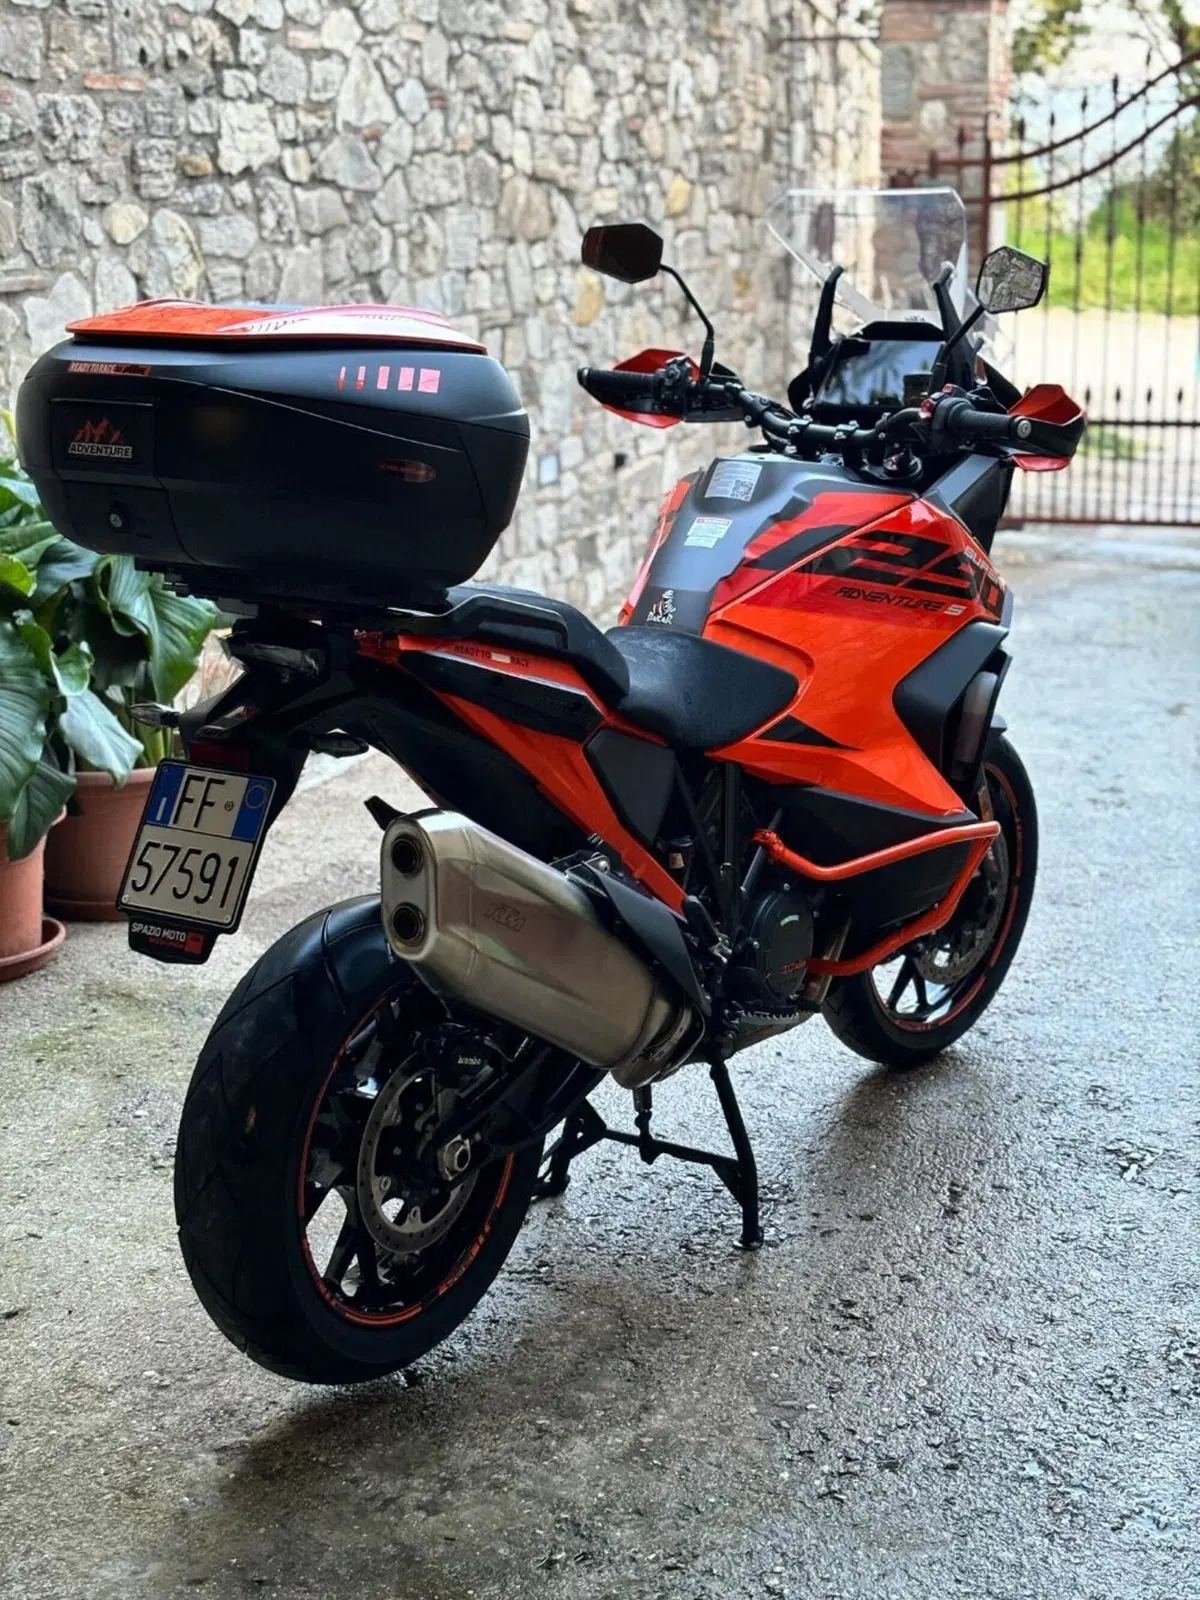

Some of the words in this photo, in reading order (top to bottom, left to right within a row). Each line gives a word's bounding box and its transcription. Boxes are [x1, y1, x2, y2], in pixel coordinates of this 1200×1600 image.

[68, 441, 133, 459] ADVENTURE
[835, 586, 944, 613] ADVENTURE
[172, 774, 226, 829] FF
[131, 840, 240, 909] 57591
[483, 902, 529, 933] KTM
[131, 922, 162, 938] SPAZIO
[161, 927, 187, 943] MOTO
